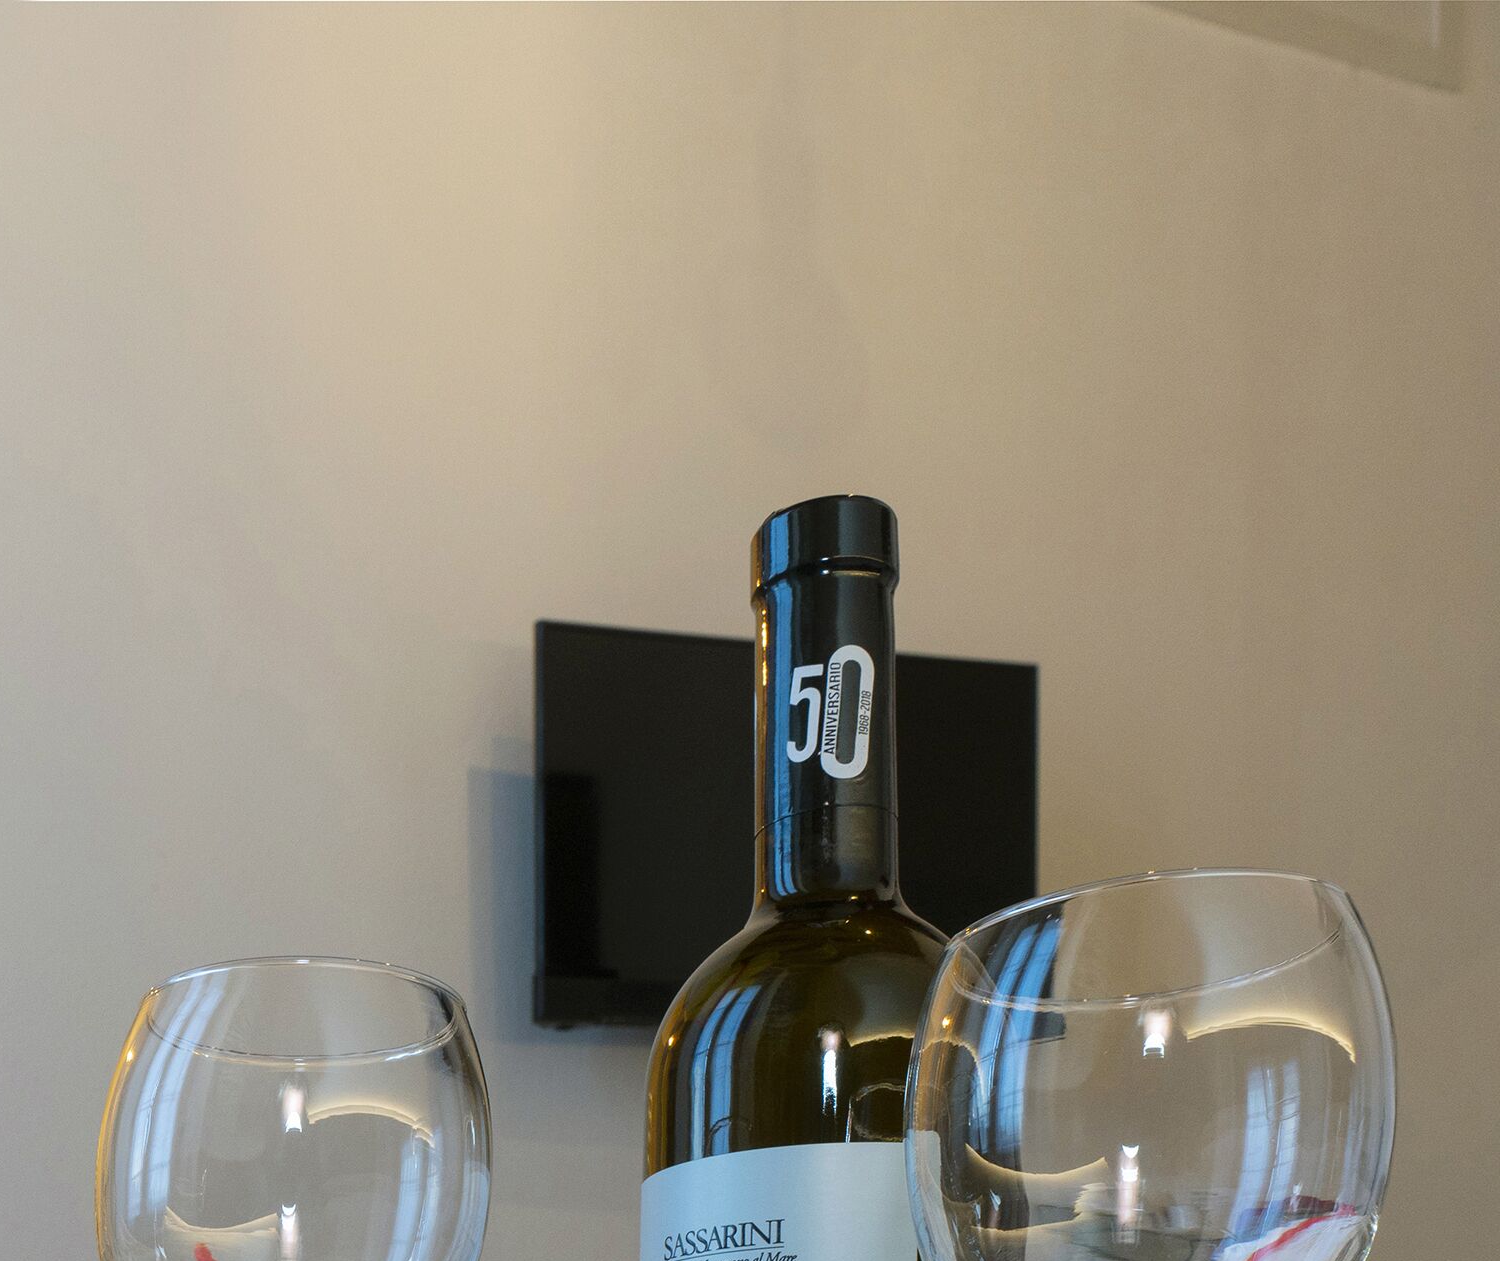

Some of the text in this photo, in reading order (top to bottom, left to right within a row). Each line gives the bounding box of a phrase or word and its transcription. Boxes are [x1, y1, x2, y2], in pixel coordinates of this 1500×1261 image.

[786, 644, 875, 779] 50
[823, 661, 842, 755] ANNIVERSARIO
[858, 690, 872, 736] 1968-2018
[663, 1218, 785, 1261] SASSARINI
